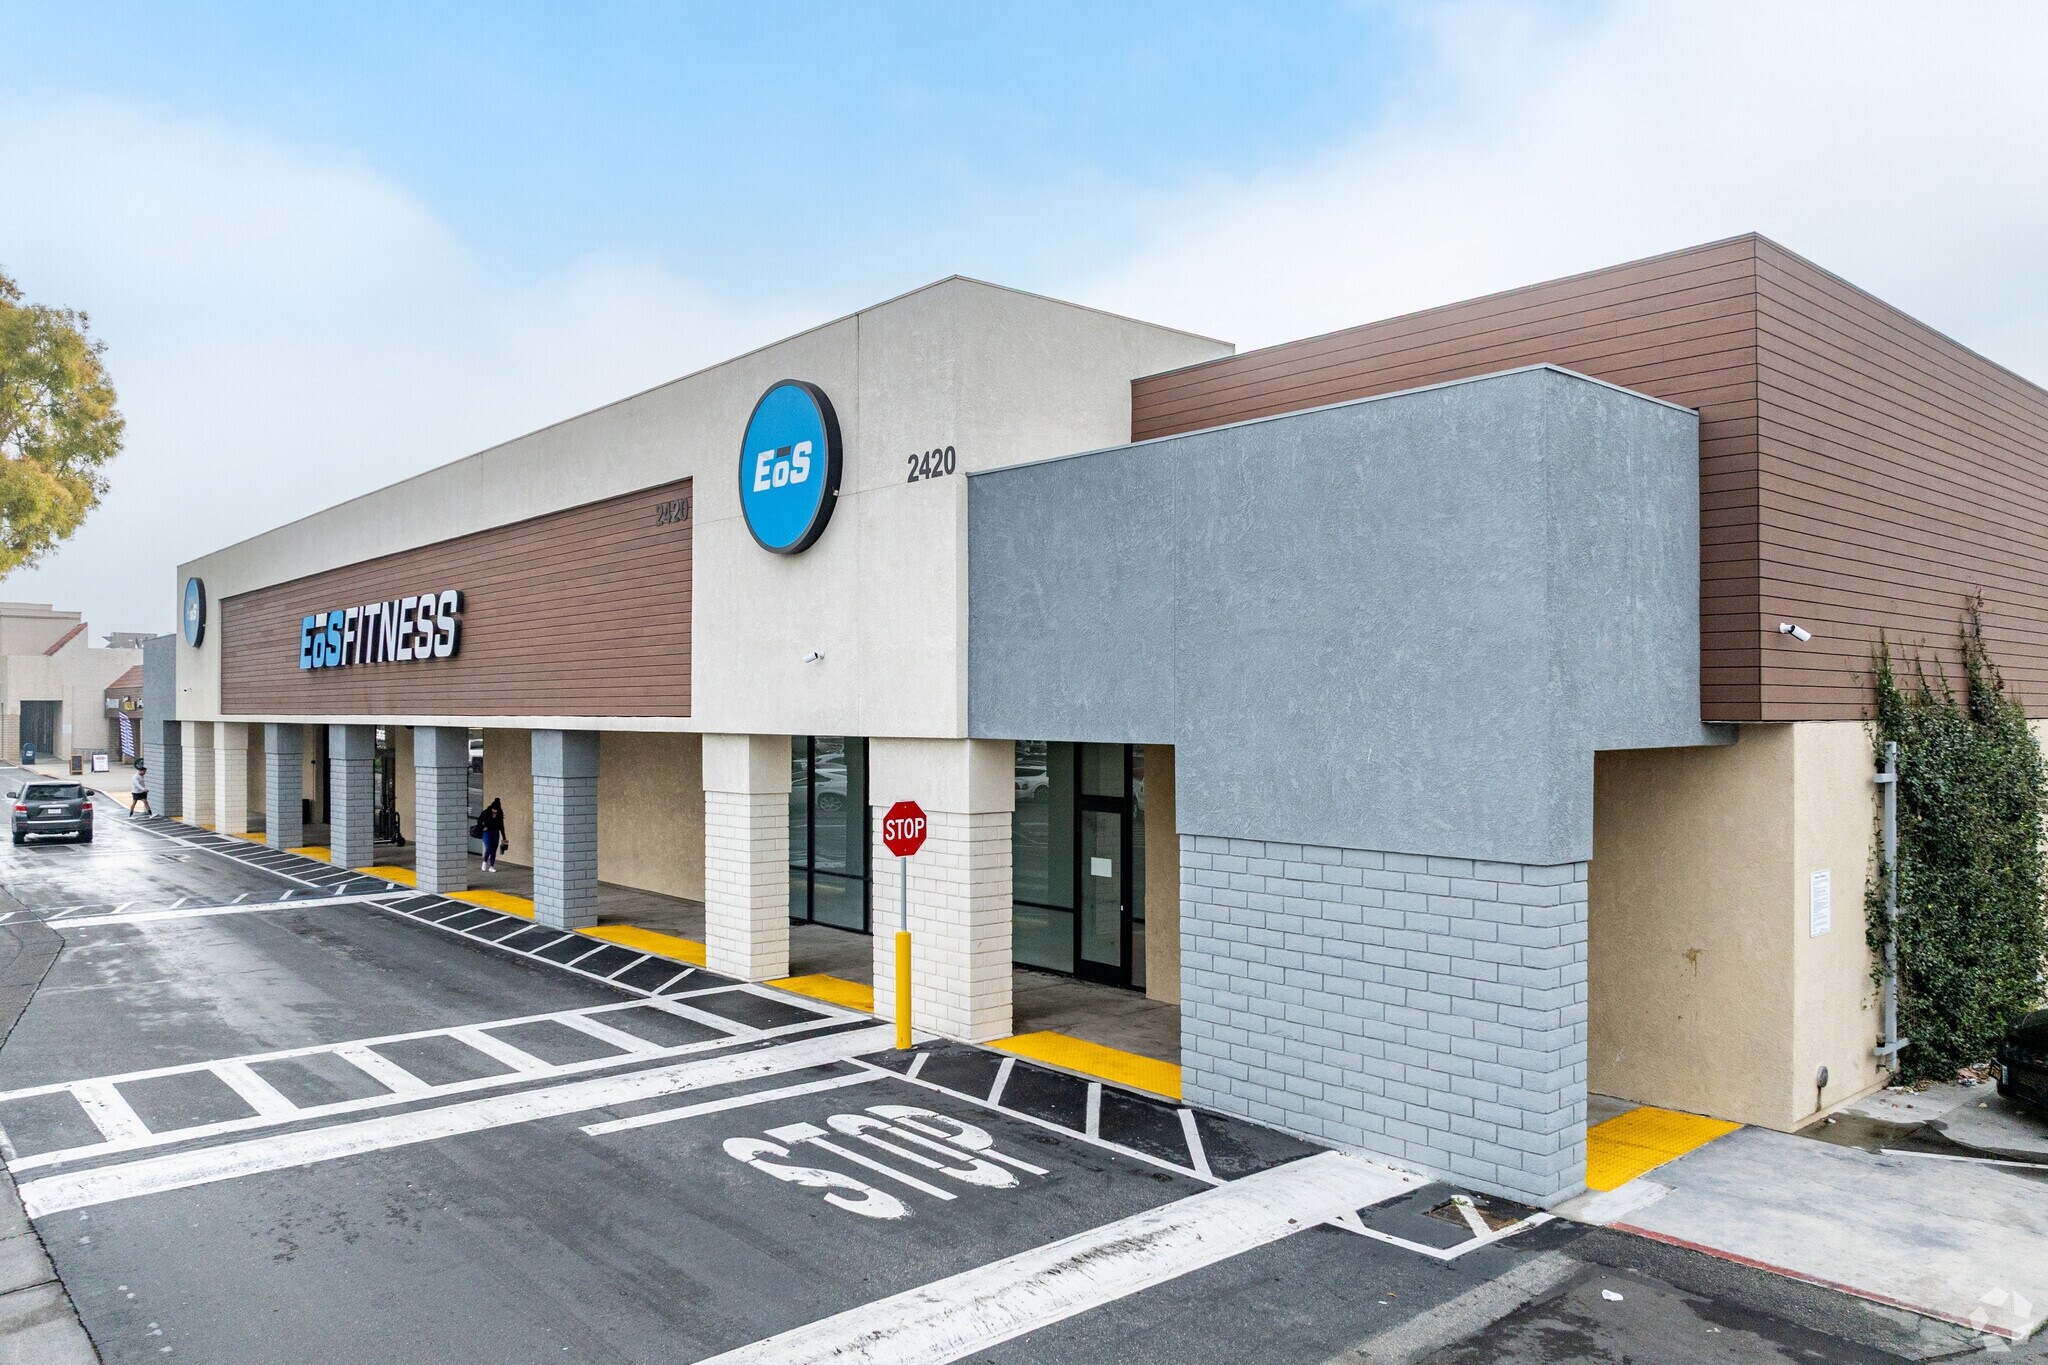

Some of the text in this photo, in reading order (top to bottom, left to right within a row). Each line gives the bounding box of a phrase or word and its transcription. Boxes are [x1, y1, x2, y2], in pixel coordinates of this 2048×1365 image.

[907, 445, 956, 483] 2420
[655, 498, 689, 527] 2420
[885, 817, 925, 841] STOP
[722, 1104, 1050, 1220] STOP
